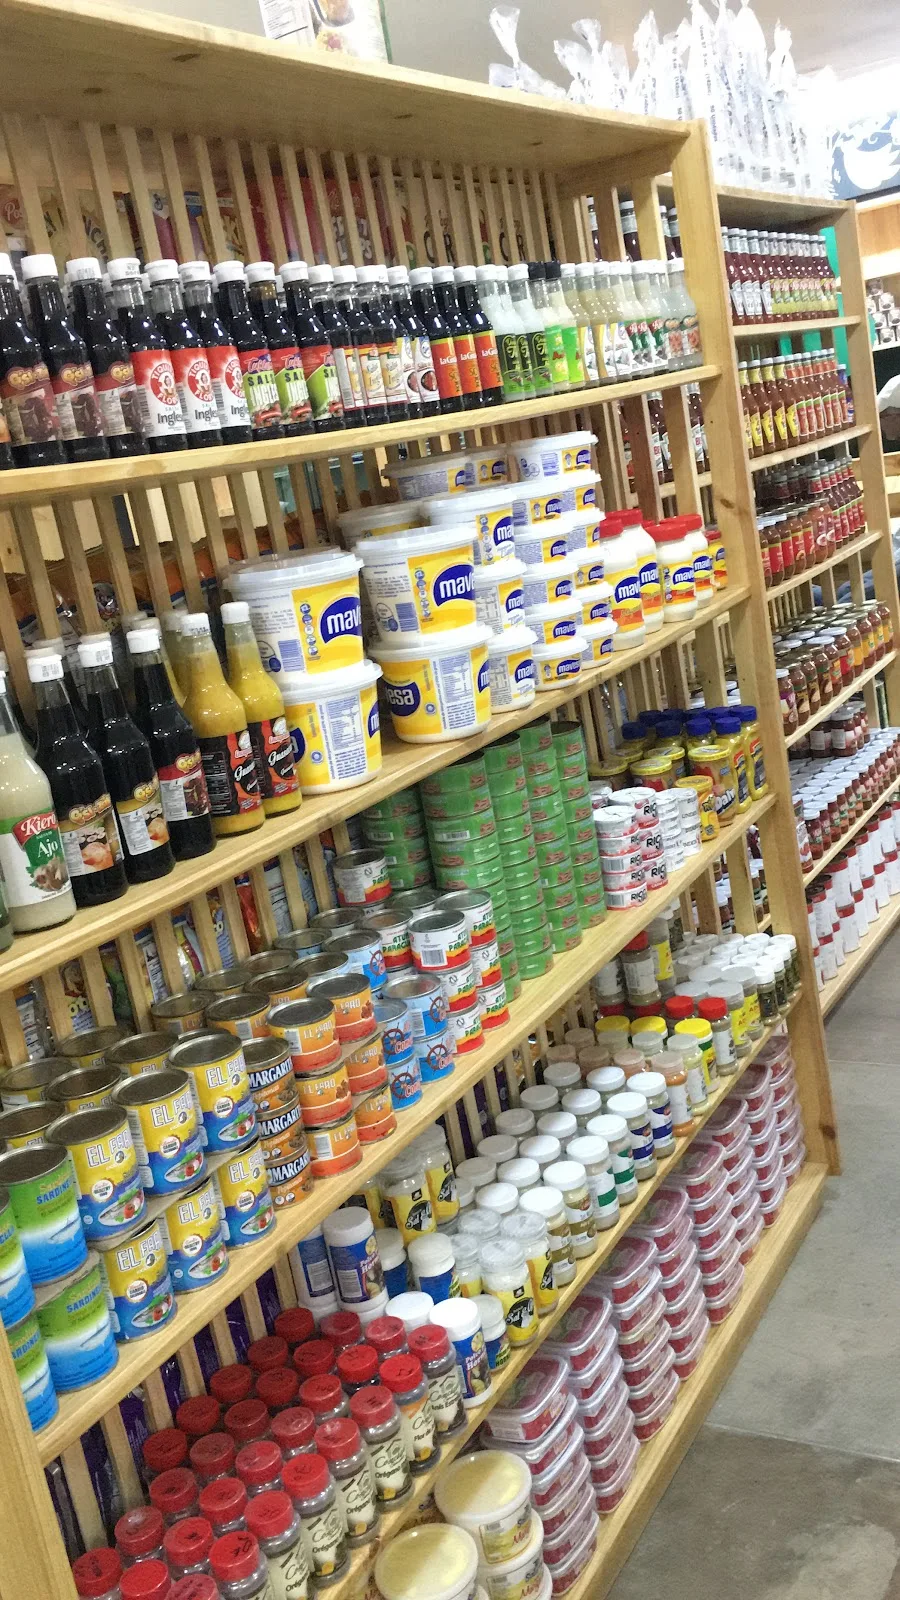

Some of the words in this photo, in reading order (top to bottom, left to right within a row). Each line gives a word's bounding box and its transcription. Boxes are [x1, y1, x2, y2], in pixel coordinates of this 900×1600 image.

[38, 838, 58, 858] Ajo
[206, 1067, 227, 1088] EL
[150, 1105, 173, 1128] EL
[86, 1144, 110, 1168] EL
[229, 1161, 248, 1184] EL
[178, 1202, 199, 1224] EL
[117, 1248, 141, 1272] EL
